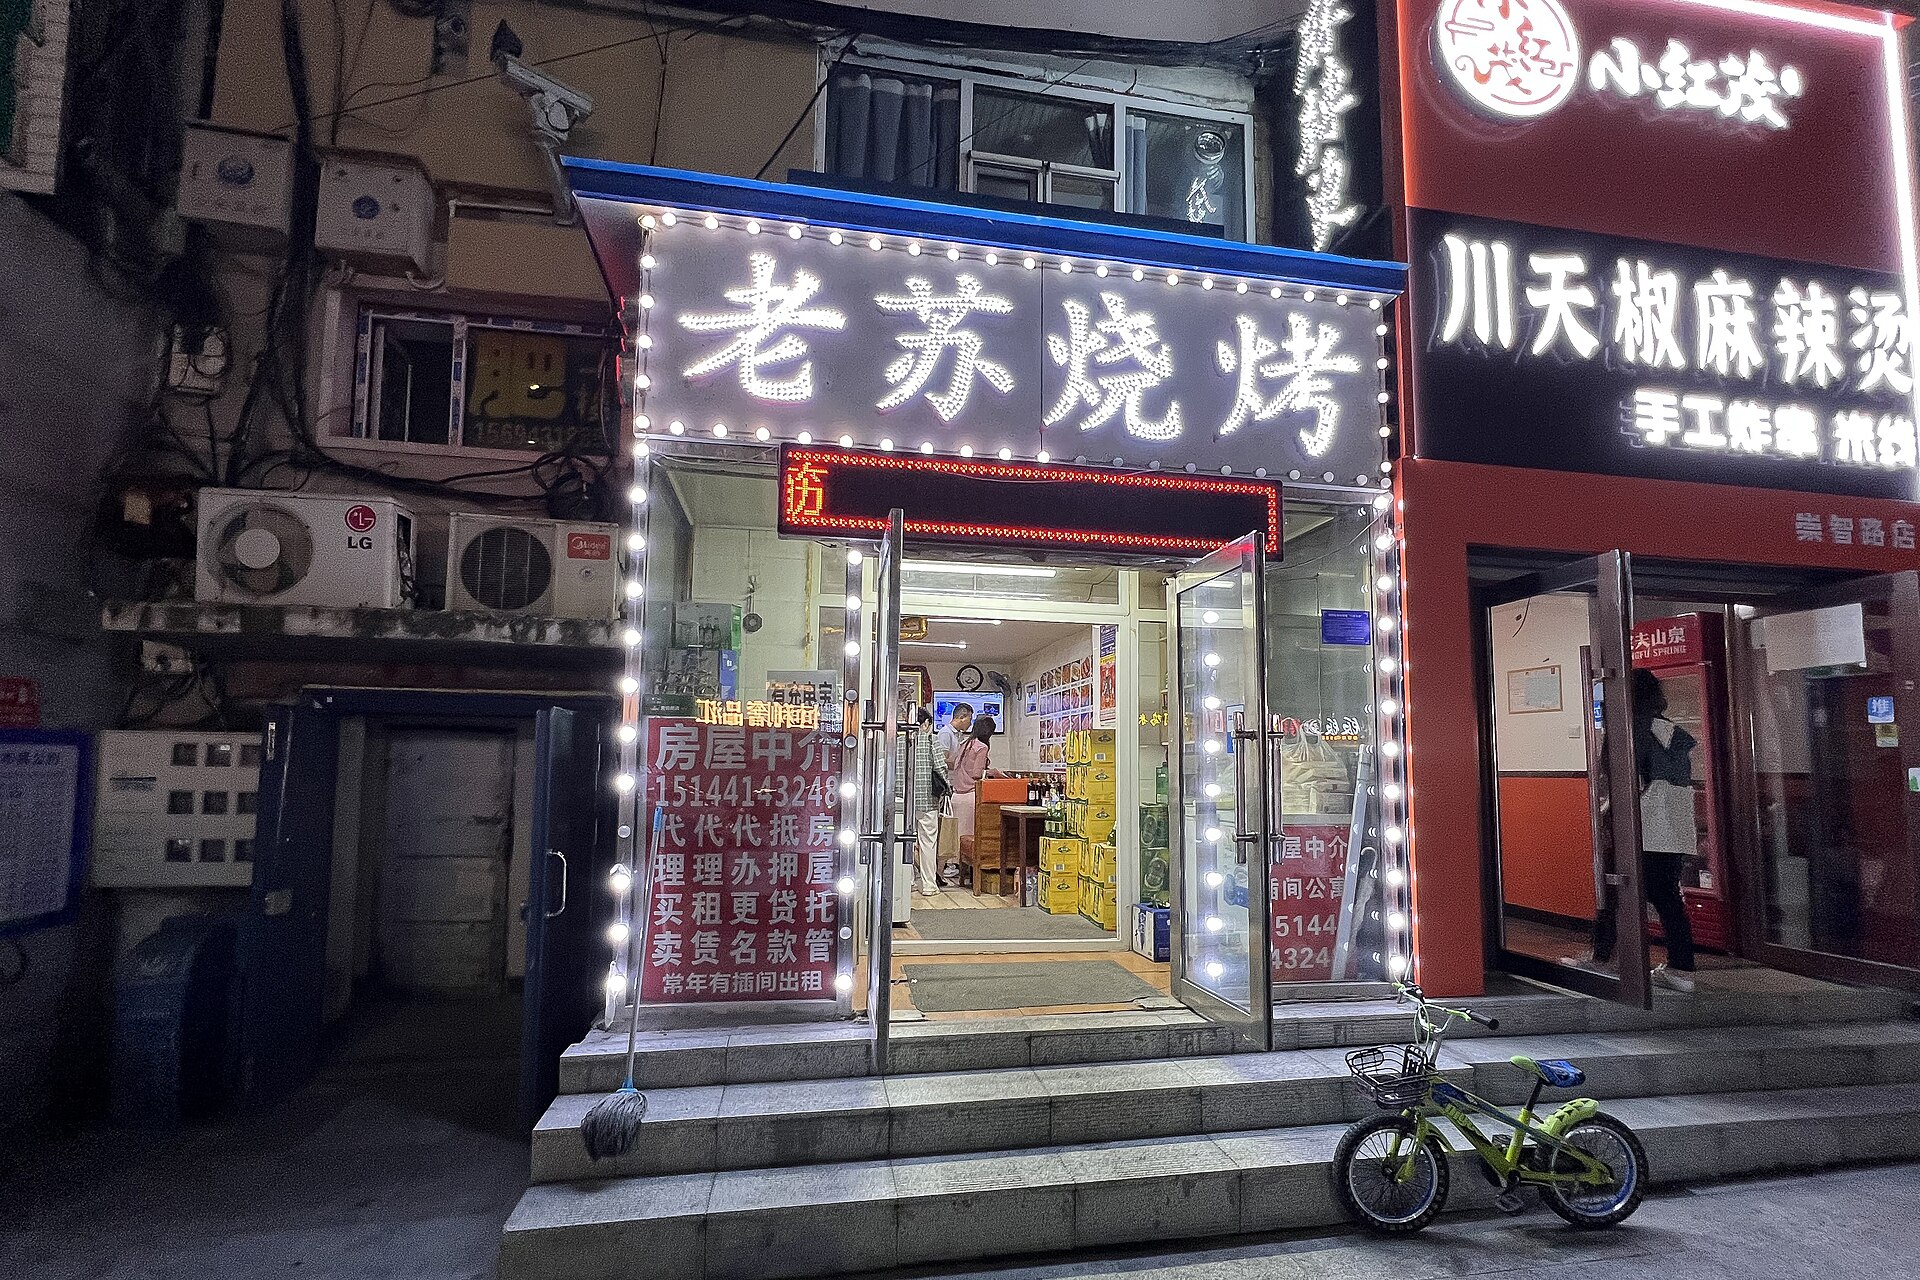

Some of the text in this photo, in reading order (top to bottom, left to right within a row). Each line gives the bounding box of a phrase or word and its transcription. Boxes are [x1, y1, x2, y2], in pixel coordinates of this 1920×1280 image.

[678, 252, 1361, 459] 老苏烧烤
[1442, 234, 1914, 393] 川天椒麻辣烫
[347, 536, 373, 550] LG
[1795, 512, 1915, 549] 崇智路店
[654, 722, 838, 772] 房屋中介
[1871, 698, 1890, 715] 推
[655, 773, 839, 808] 15144143248
[651, 813, 686, 967] 代理买卖
[690, 813, 725, 966] 代理租赁
[728, 813, 762, 966] 代办更名
[766, 812, 800, 966] 抵押贷款
[804, 811, 839, 964] 房屋托管
[662, 969, 824, 995] 常年有插间出租
